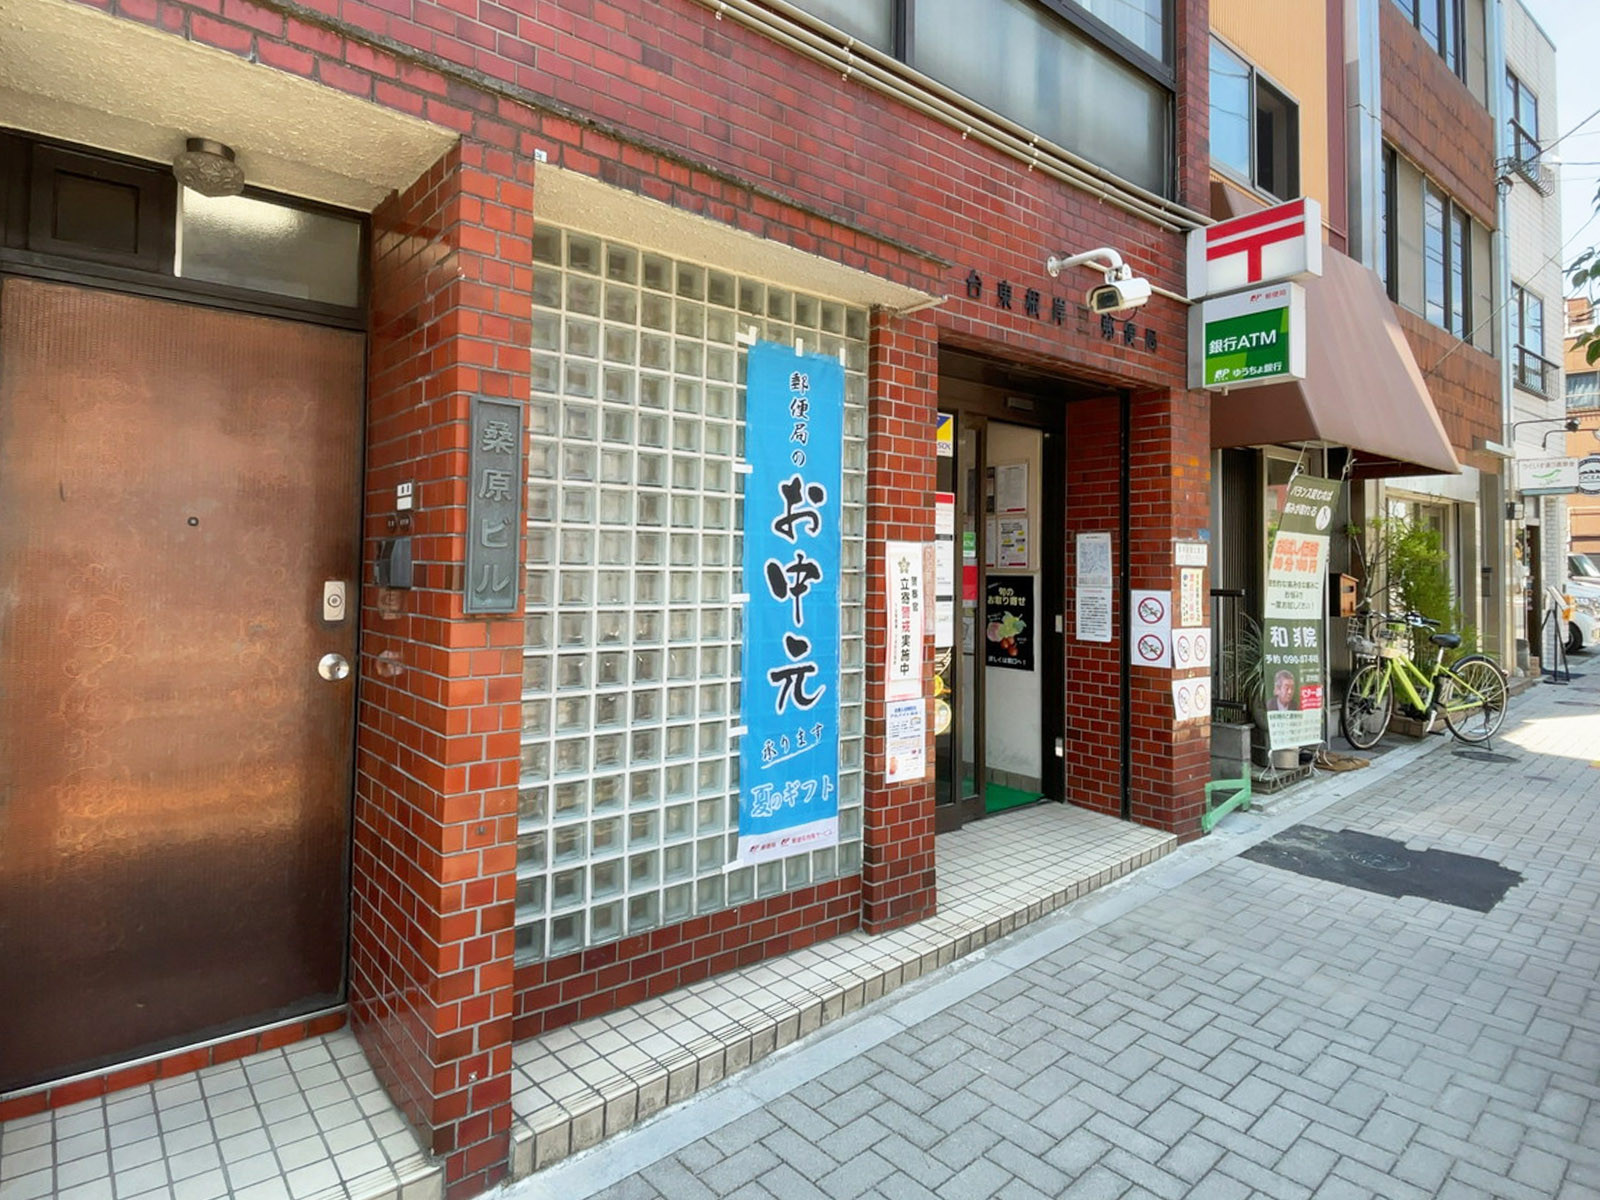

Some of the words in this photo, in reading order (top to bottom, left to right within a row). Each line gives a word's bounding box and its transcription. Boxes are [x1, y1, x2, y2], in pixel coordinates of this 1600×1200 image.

[1208, 329, 1277, 355] 銀行ATM
[1232, 361, 1282, 378] ゆうちょ銀行
[790, 372, 809, 466] 郵便局の
[475, 420, 515, 593] 桑原ビル
[766, 476, 825, 714] お中元
[987, 595, 1026, 607] お取り寄せ
[762, 723, 823, 762] 承ります
[751, 775, 834, 818] 夏のギフト
